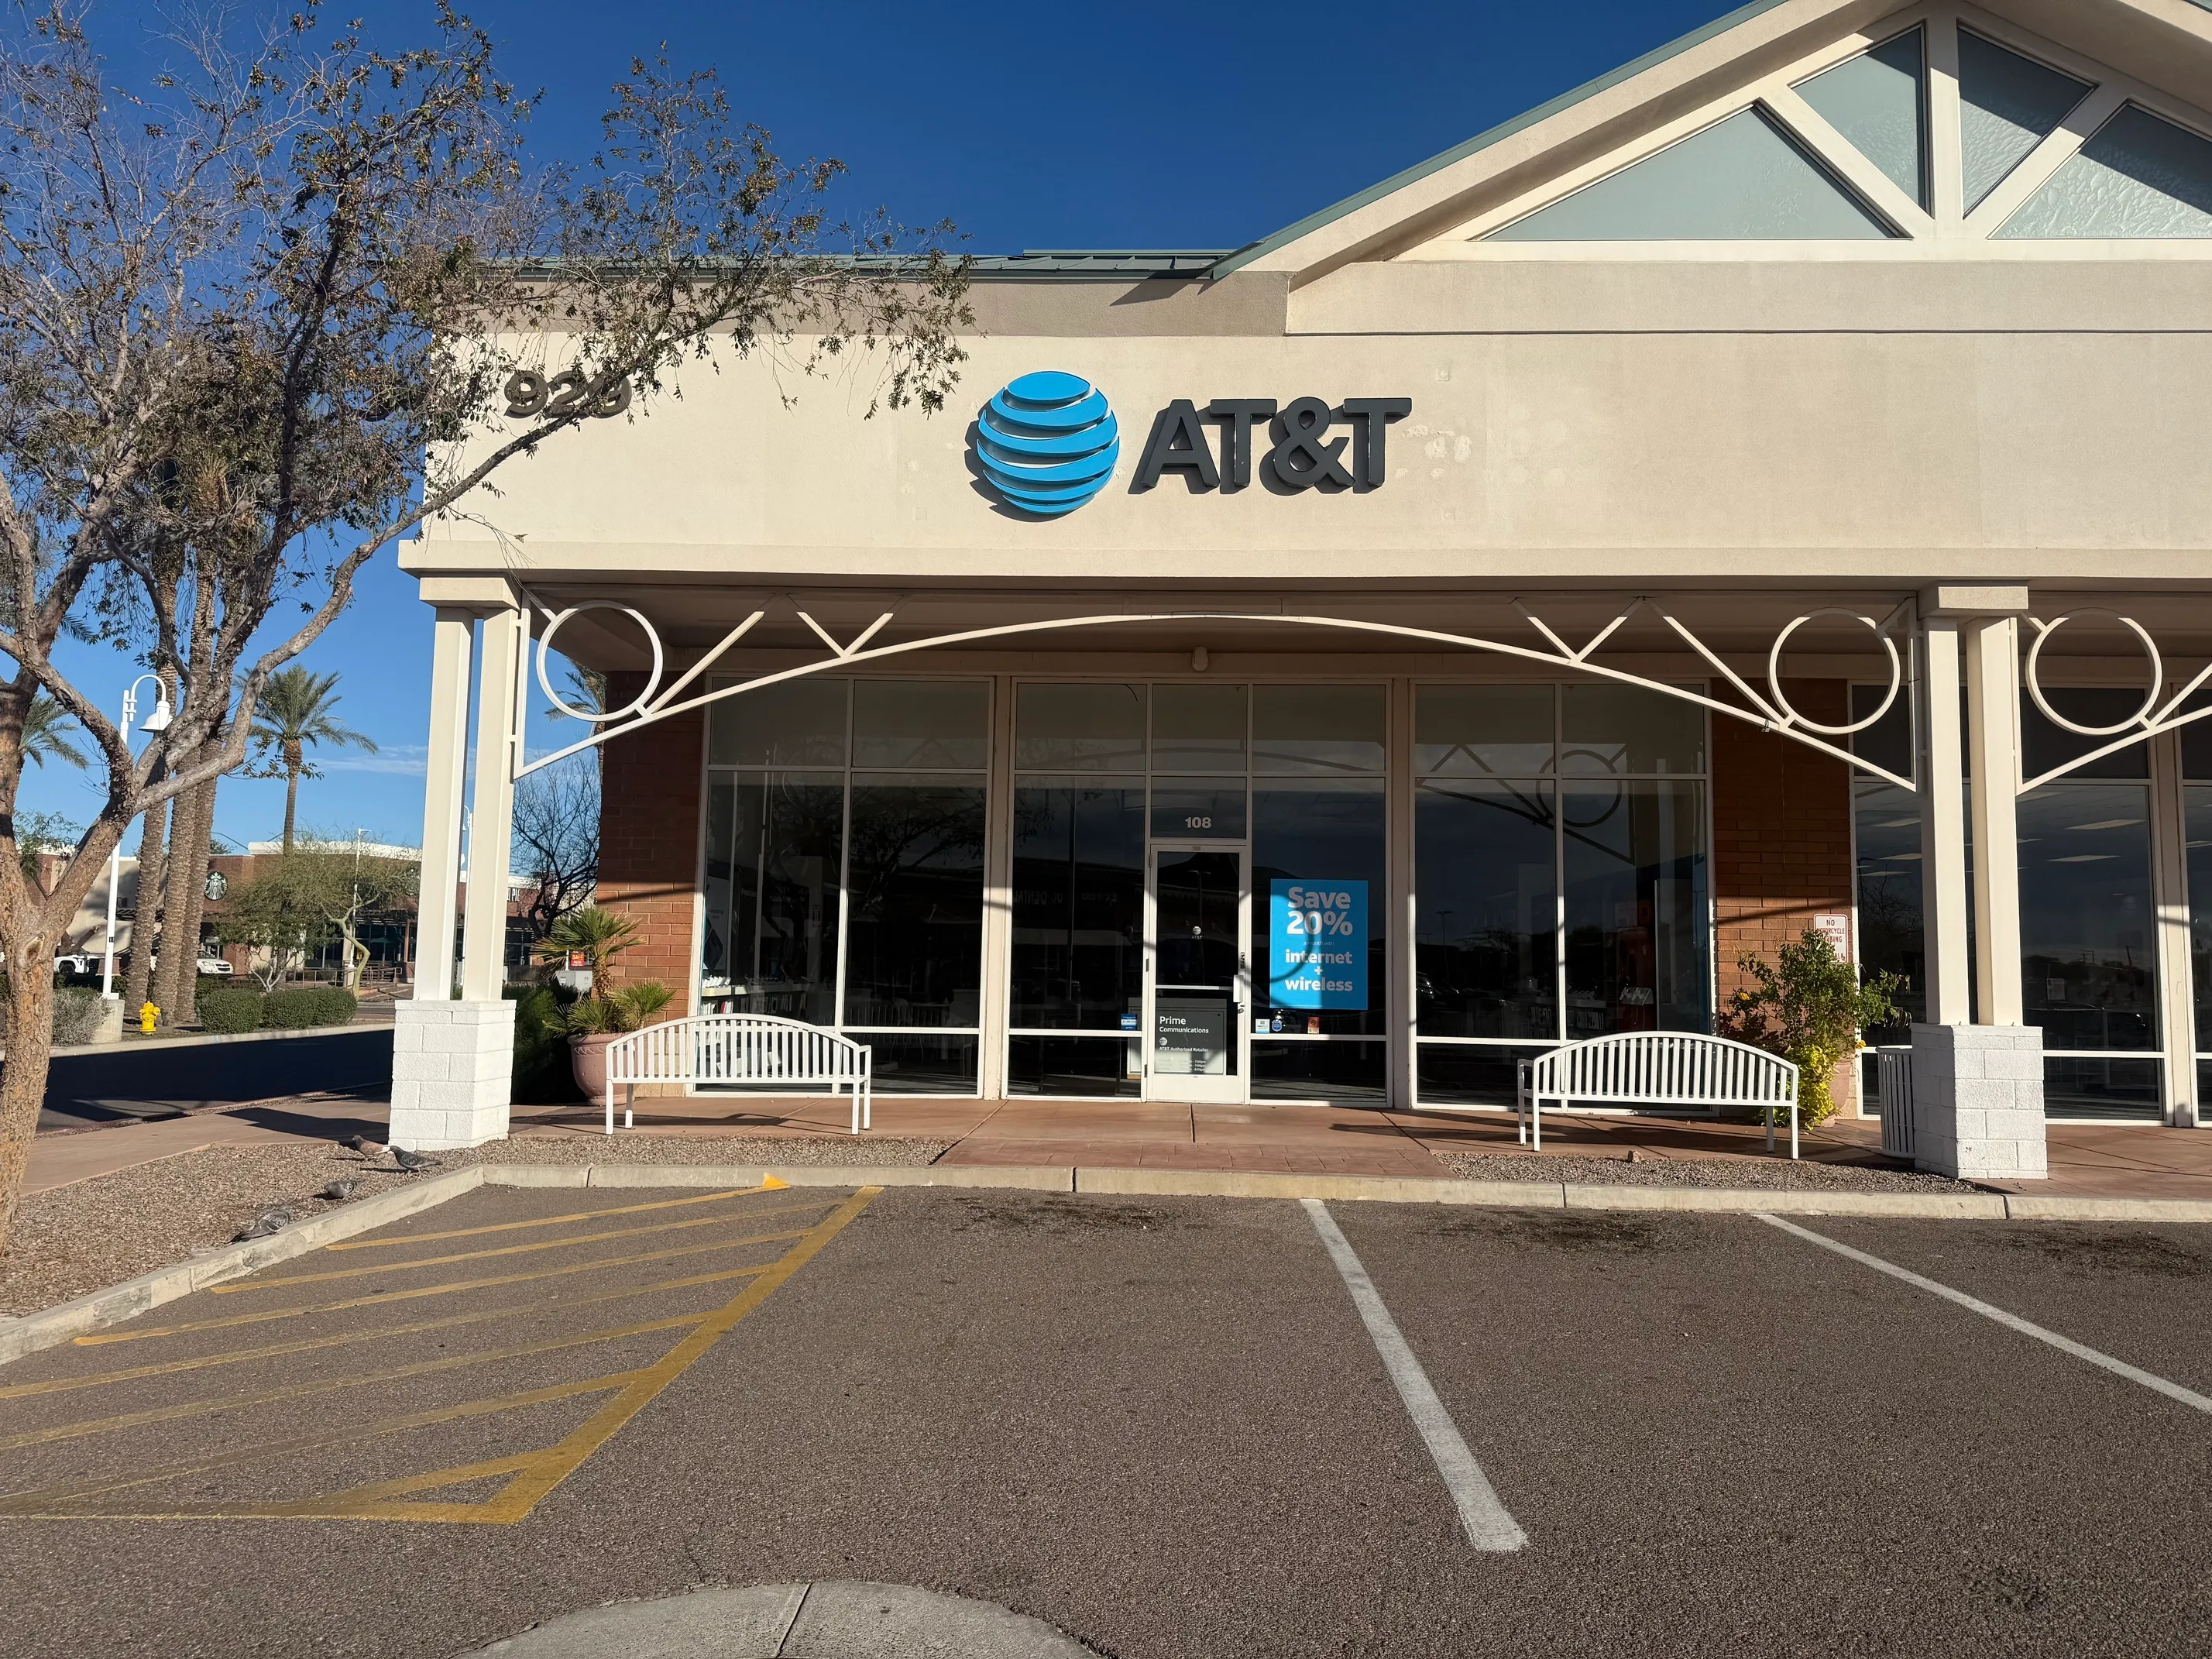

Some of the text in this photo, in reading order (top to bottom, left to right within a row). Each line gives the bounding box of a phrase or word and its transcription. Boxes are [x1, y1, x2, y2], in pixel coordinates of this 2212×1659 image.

[1139, 396, 1413, 489] AT&T
[1185, 817, 1212, 829] 108
[1287, 886, 1352, 909] Save
[1286, 910, 1353, 936] 20%
[1286, 949, 1353, 964] internet
[1314, 966, 1324, 975] +
[1285, 976, 1353, 991] wireless
[1159, 1016, 1187, 1025] Prime
